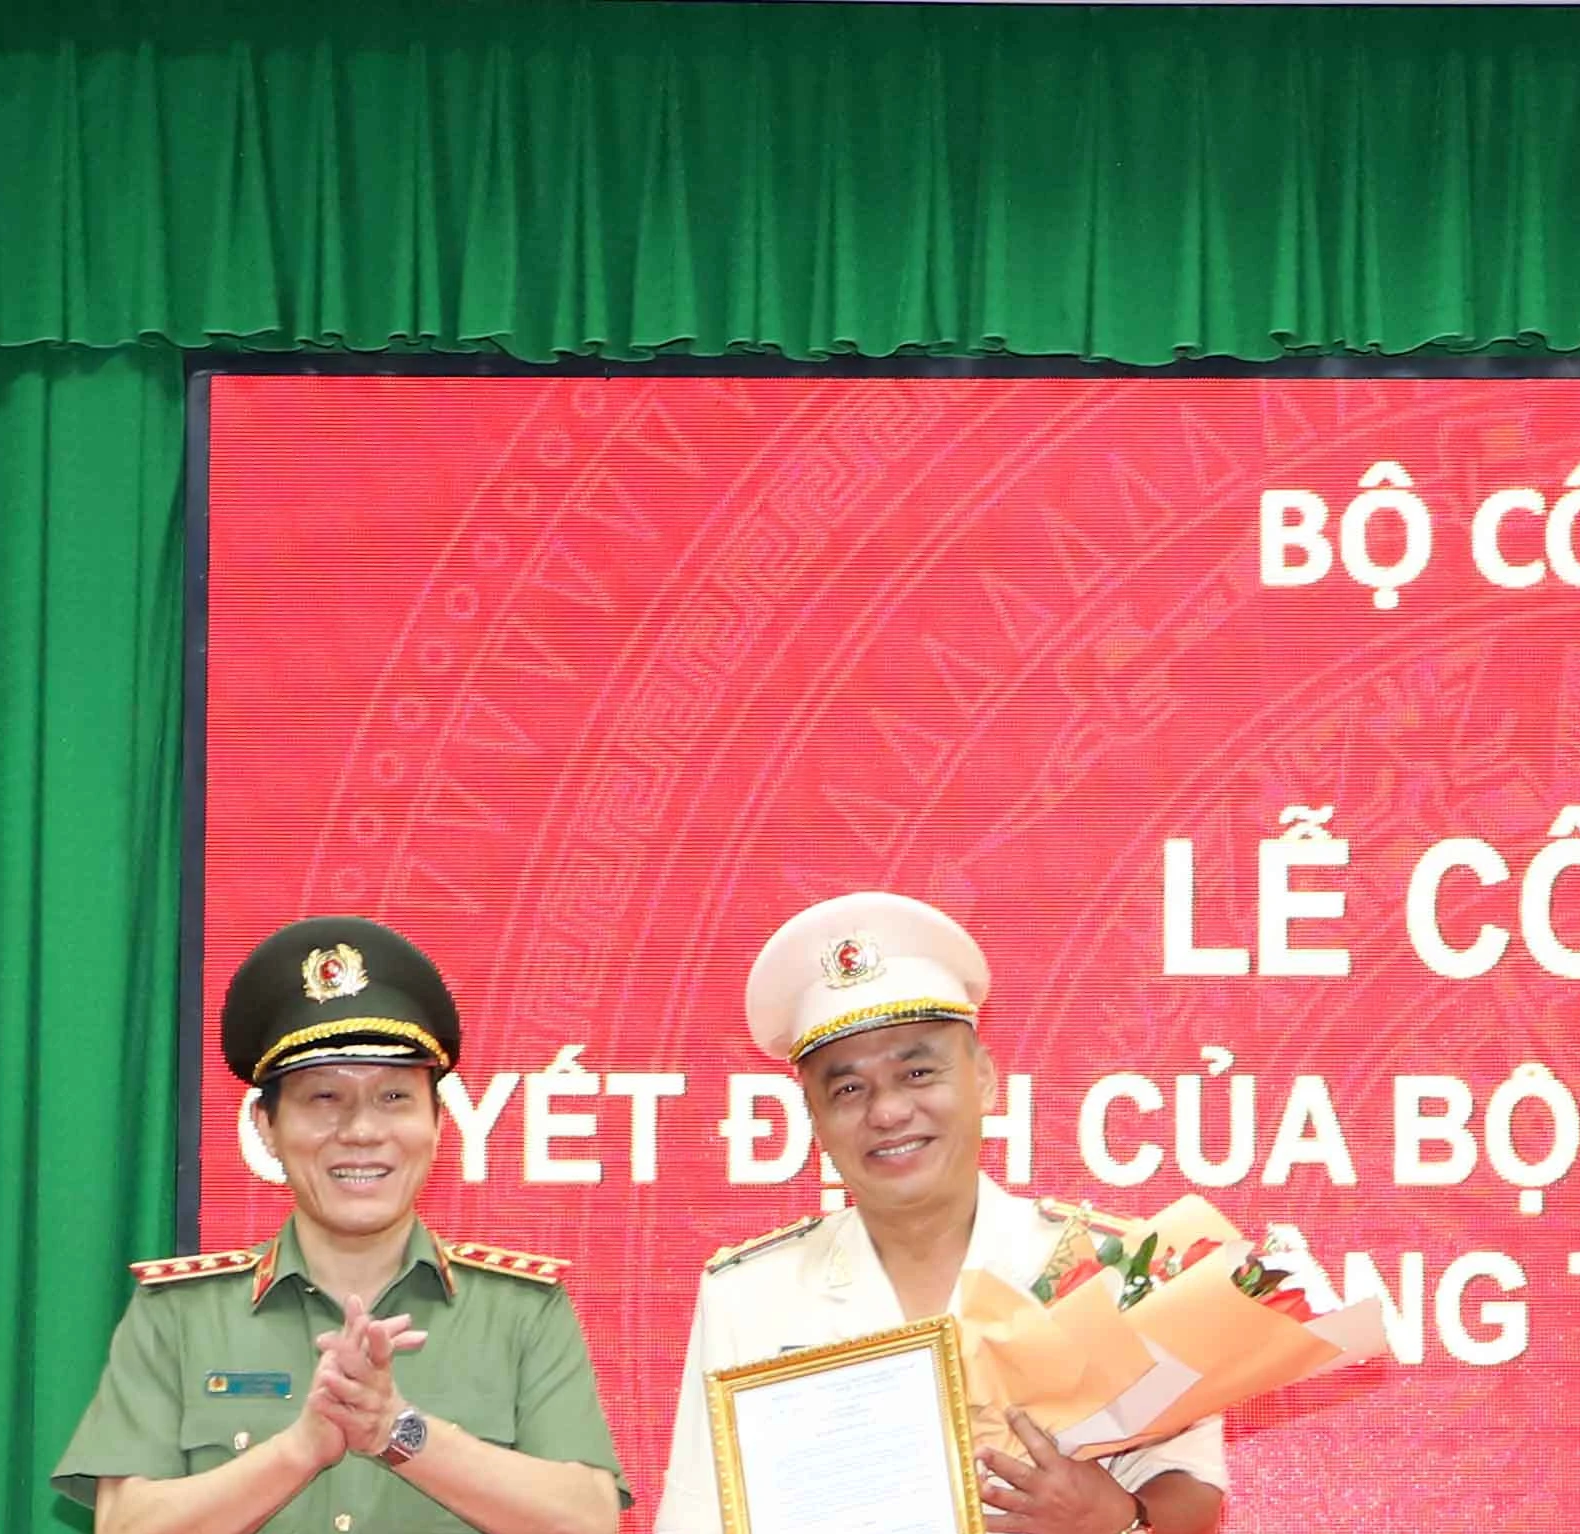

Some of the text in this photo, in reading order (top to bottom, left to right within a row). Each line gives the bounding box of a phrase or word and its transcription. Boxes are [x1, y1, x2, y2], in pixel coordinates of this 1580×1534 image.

[1258, 460, 1434, 610] BỘ
[1162, 803, 1352, 977] LỄ
[238, 1044, 686, 1184] YẾT
[718, 1073, 1033, 1212] ĐH
[1076, 1044, 1358, 1189] CỦA
